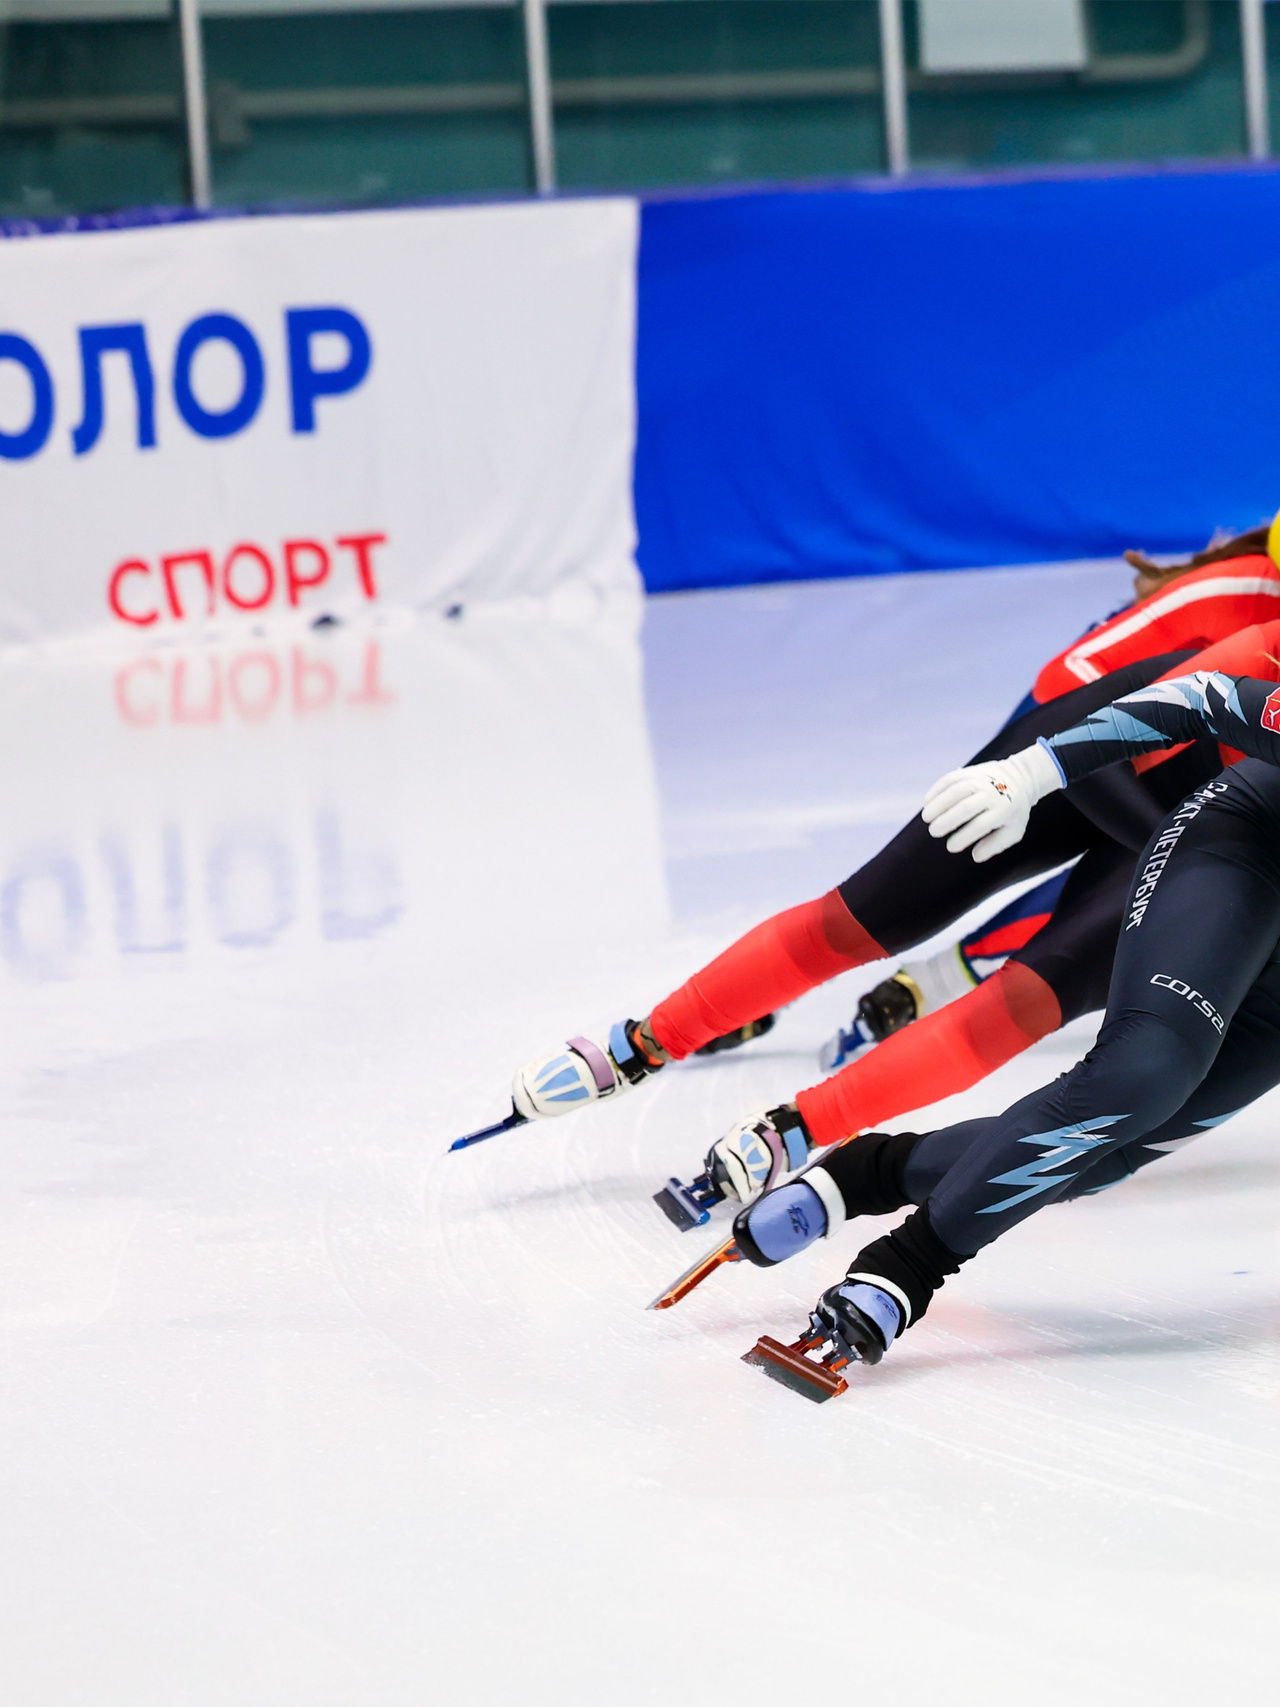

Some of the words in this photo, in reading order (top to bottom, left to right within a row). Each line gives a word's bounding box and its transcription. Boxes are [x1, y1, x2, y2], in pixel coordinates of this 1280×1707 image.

[107, 531, 388, 628] СПОРТ
[1125, 781, 1229, 931] САНКТ-ПЕТЕРБУРГ
[1149, 973, 1225, 1035] corsa
